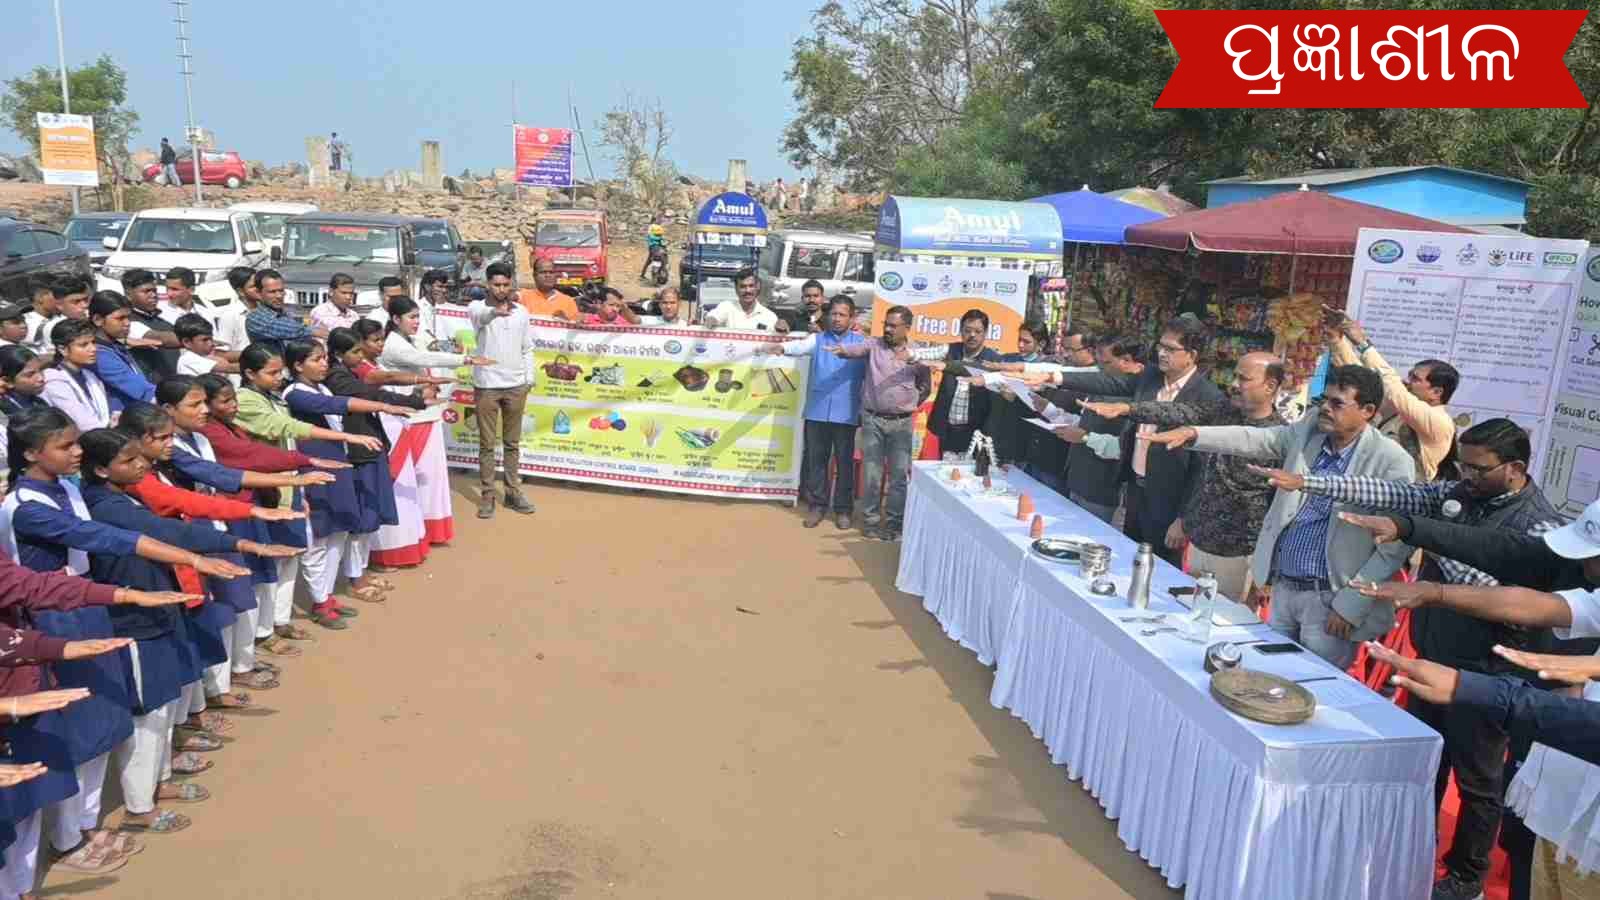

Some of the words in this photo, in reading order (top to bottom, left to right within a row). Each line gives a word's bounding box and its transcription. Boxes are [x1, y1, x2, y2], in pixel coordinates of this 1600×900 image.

[712, 199, 754, 215] Amul
[942, 205, 1023, 231] Amul
[1509, 250, 1535, 262] LiFE
[917, 315, 946, 335] Free
